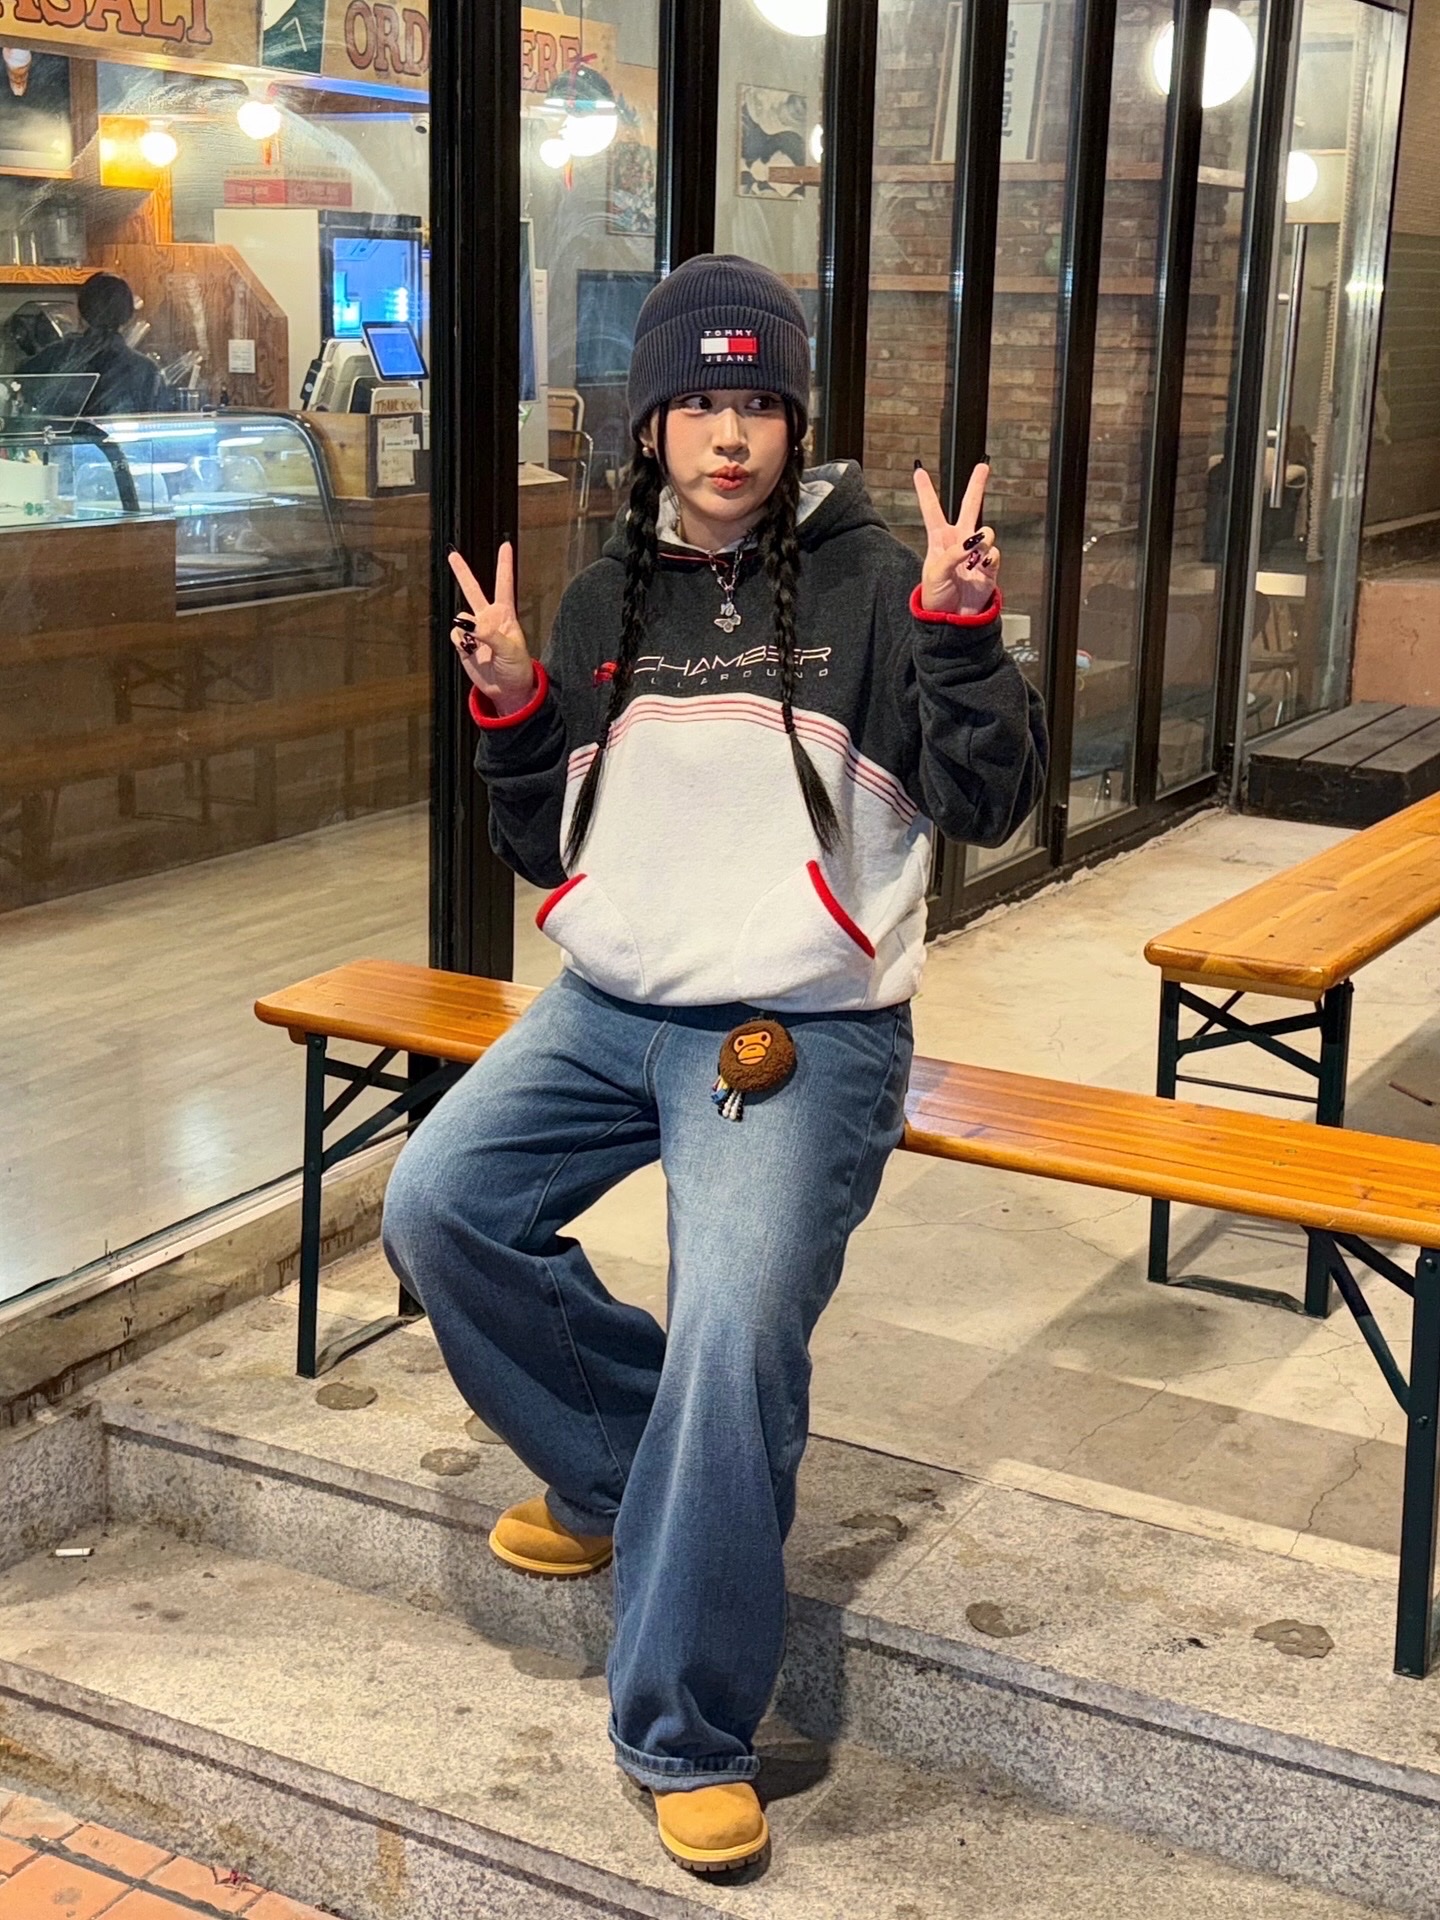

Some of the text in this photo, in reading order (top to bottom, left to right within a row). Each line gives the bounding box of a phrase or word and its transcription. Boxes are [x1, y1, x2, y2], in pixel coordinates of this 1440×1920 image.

[703, 329, 752, 337] TOMMY
[705, 354, 753, 362] JEANS
[633, 645, 832, 677] CHAMBER
